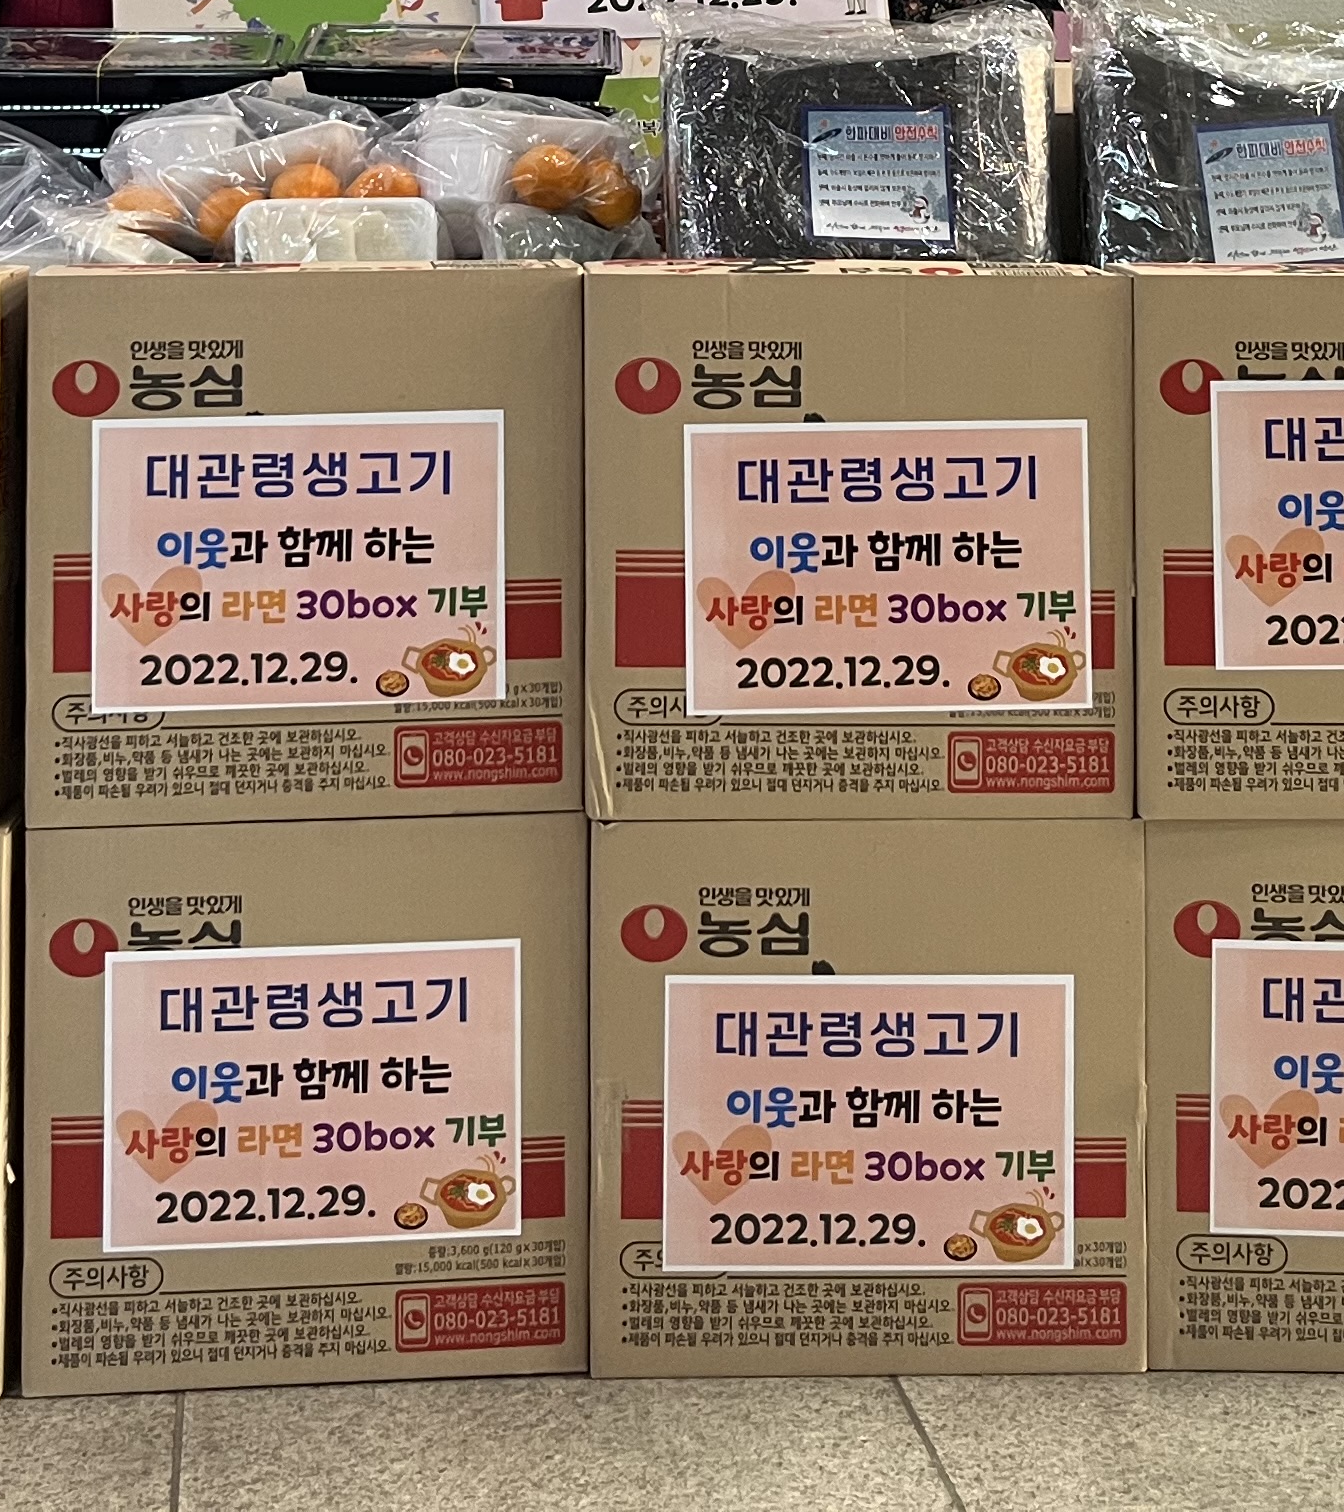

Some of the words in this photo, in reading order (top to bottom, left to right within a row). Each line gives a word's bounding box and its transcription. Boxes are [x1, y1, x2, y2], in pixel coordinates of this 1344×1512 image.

[147, 451, 451, 499] 대관령생고기
[738, 455, 1036, 503] 대관령생고기
[157, 528, 268, 570] 이웃과
[277, 526, 353, 568] 함께
[364, 526, 435, 564] 하는
[750, 532, 859, 574] 이웃과
[867, 530, 942, 572] 함께
[952, 530, 1022, 569] 하는
[1235, 553, 1333, 588] 사랑의
[110, 591, 211, 627] 사랑의
[221, 589, 286, 625] 라면
[296, 588, 417, 620] 30box
[428, 585, 488, 617] 기부
[706, 595, 804, 631] 사랑의
[814, 593, 877, 628] 라면
[888, 592, 1007, 624] 30box
[1016, 590, 1077, 622] 기부
[140, 651, 358, 687] 2022.12.29.
[736, 655, 950, 690] 2022.12.29.
[160, 977, 467, 1033] 대관령생고기
[716, 1012, 1018, 1058] 대관령생고기
[172, 1061, 284, 1104] 이웃과
[292, 1057, 369, 1101] 함께
[380, 1055, 452, 1094] 하는
[125, 1126, 226, 1164] 사랑의
[237, 1122, 302, 1159] 라면
[313, 1120, 435, 1153] 30box
[445, 1114, 507, 1147] 기부
[155, 1184, 376, 1225] 2022.12.29.
